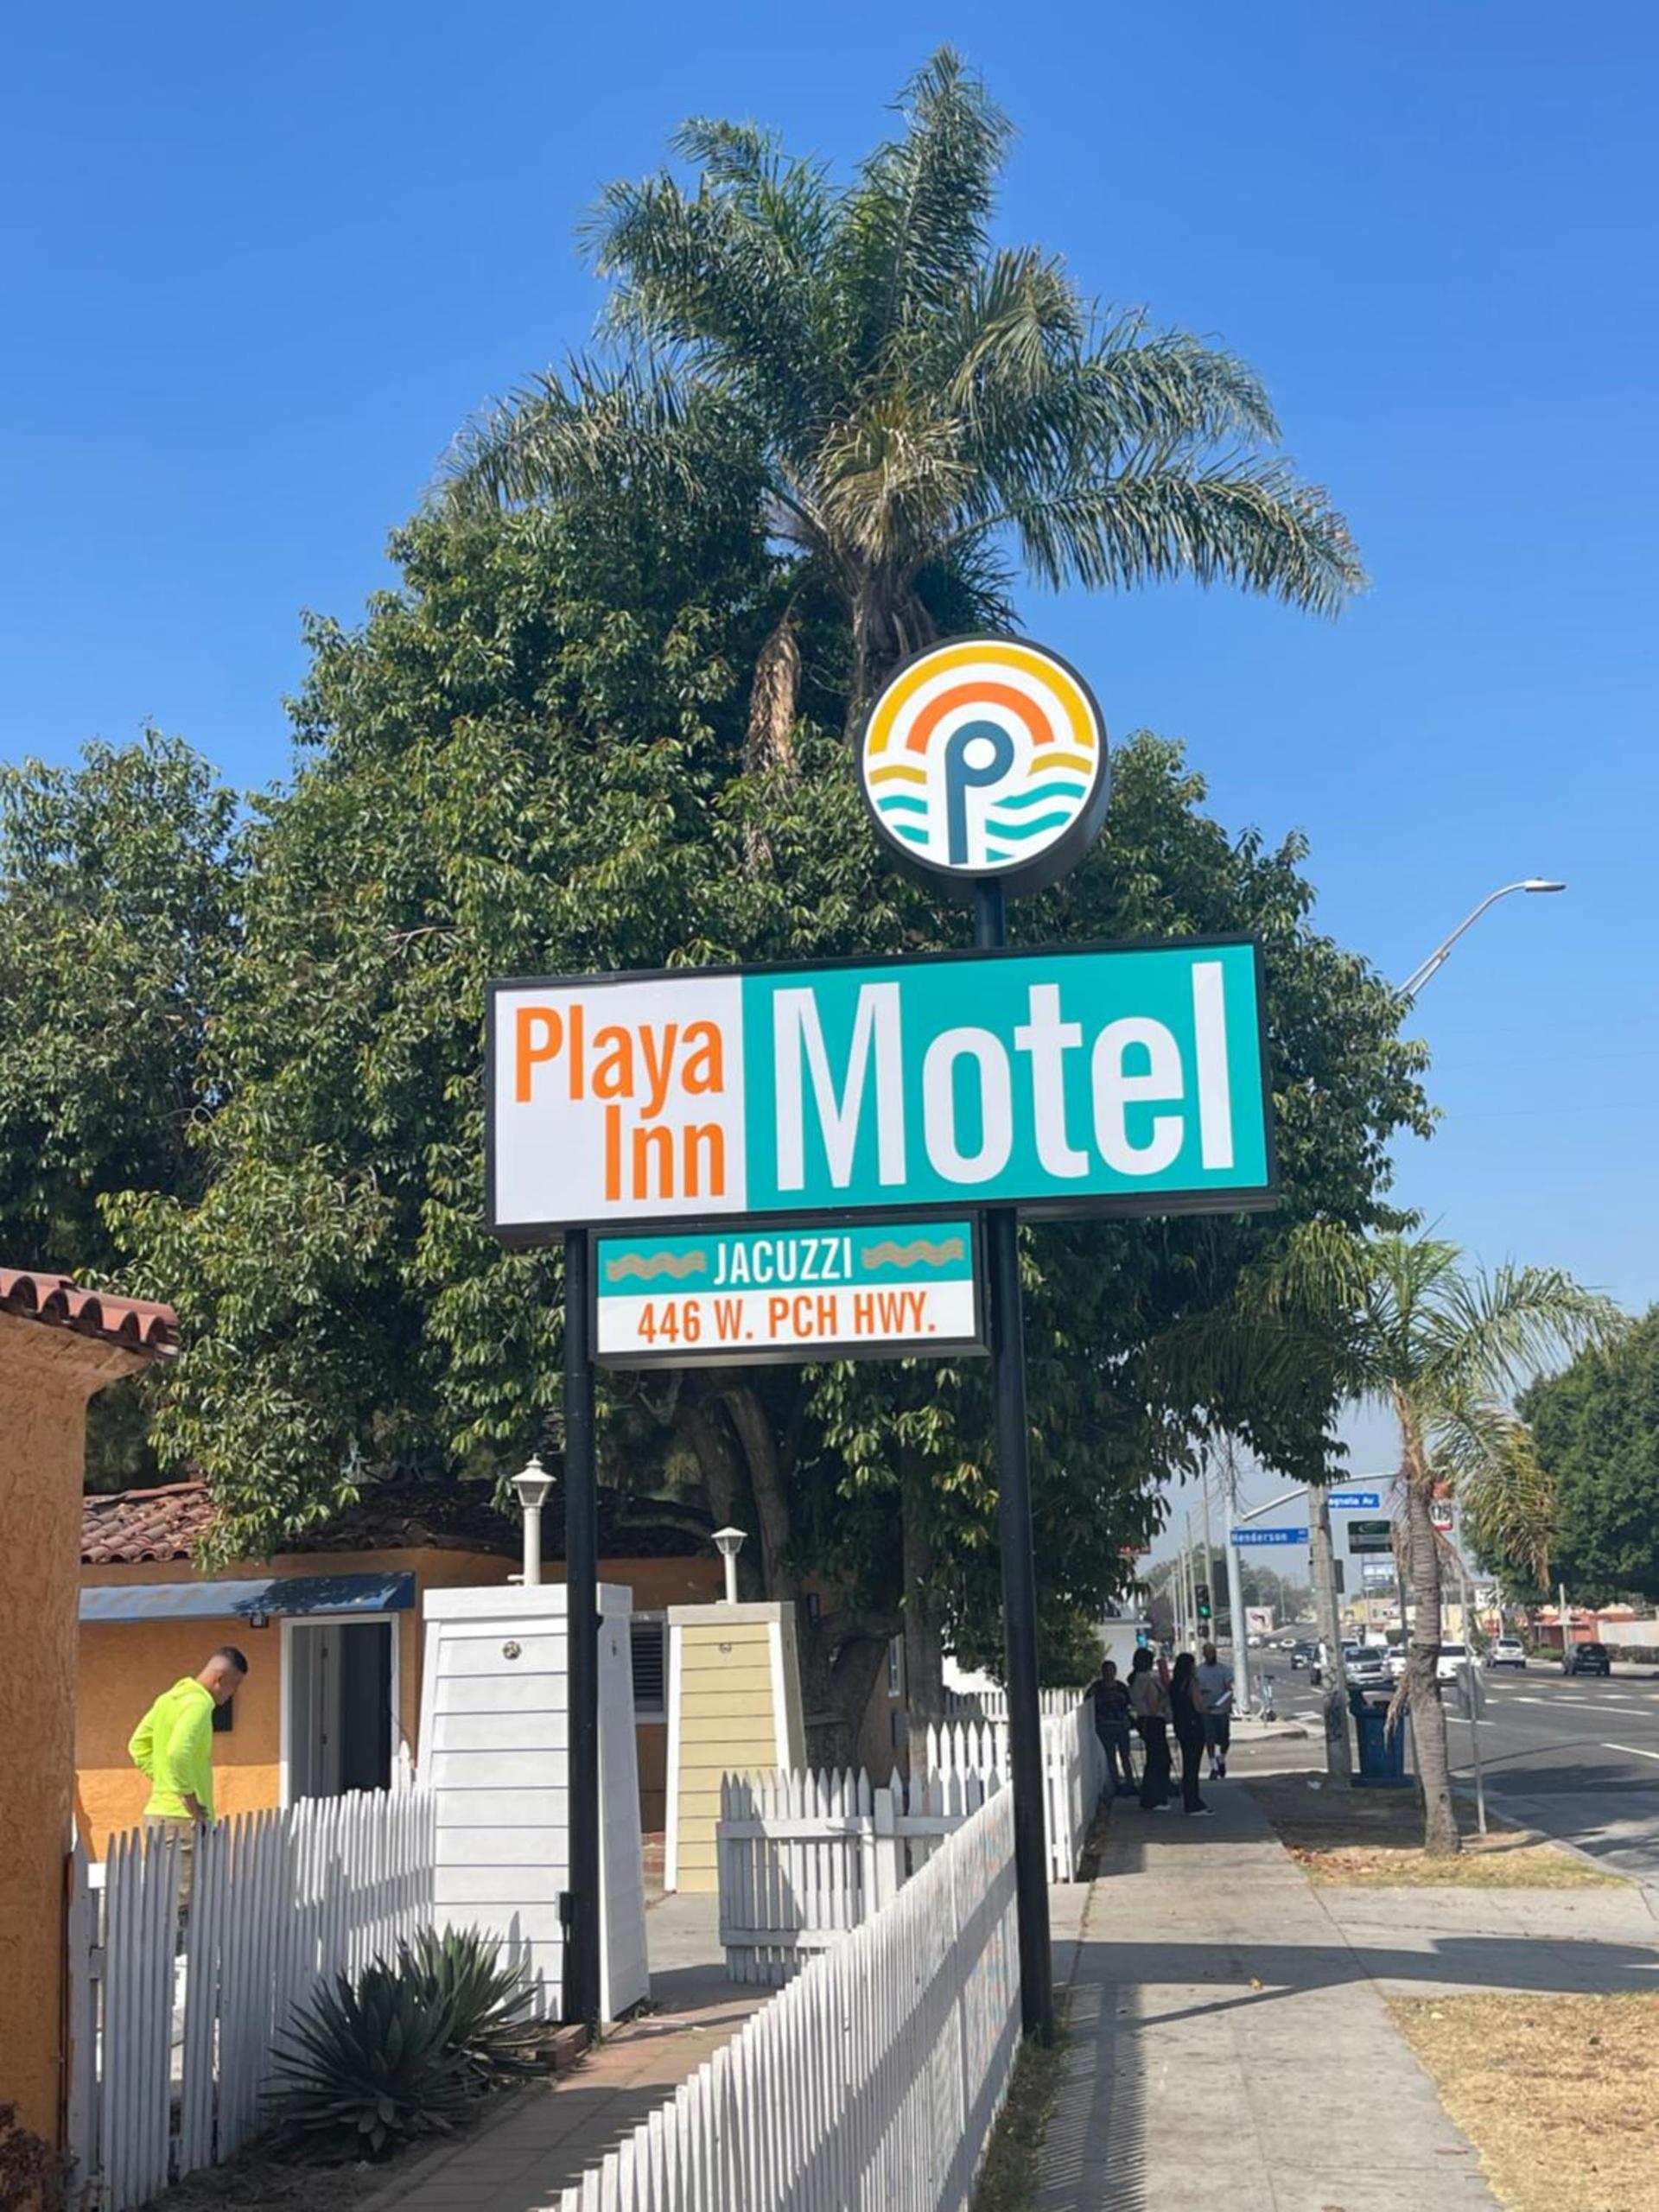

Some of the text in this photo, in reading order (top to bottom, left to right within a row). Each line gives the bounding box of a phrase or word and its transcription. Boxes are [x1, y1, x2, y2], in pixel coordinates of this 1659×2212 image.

[515, 1002, 725, 1121] Playa
[774, 961, 1234, 1191] Motel
[604, 1103, 726, 1203] Inn
[714, 1237, 853, 1285] JACUZZI
[638, 1290, 935, 1343] 446 W. PCH HWY.
